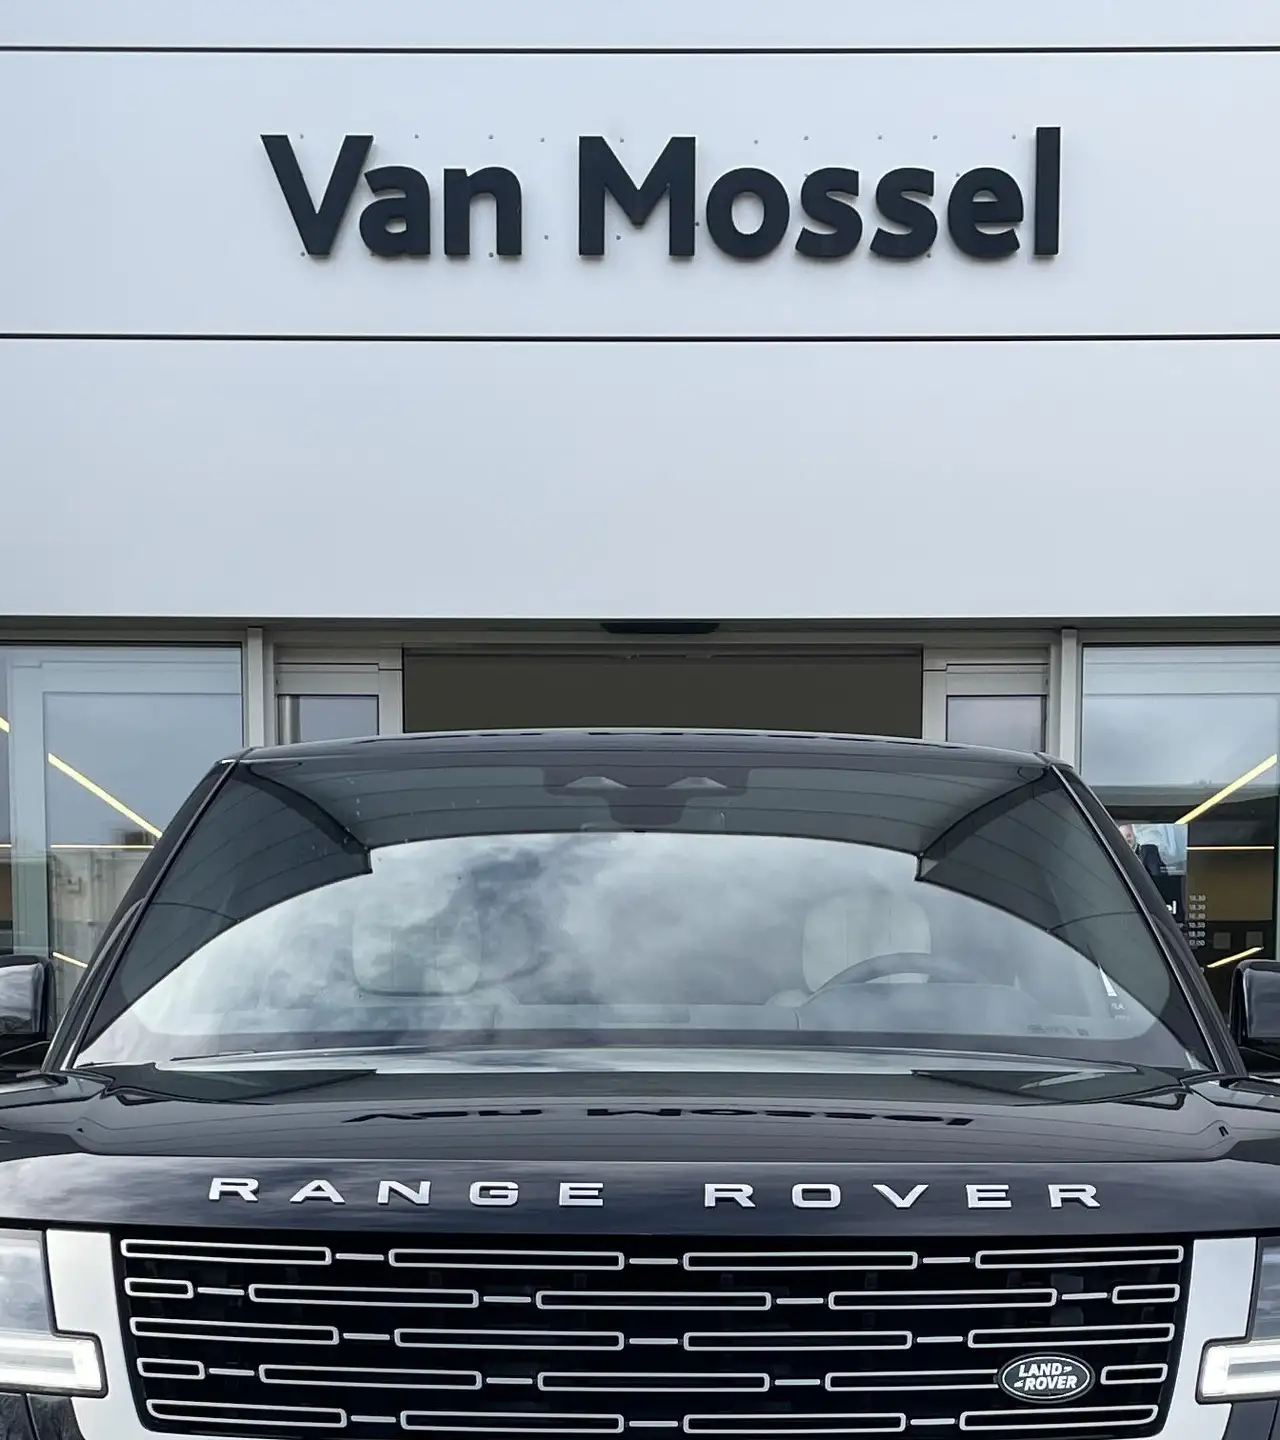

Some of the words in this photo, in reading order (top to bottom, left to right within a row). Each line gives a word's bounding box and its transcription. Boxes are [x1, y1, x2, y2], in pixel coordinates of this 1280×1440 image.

[261, 133, 523, 257] Van
[578, 127, 1062, 260] Mossel
[208, 1176, 605, 1208] RANGE
[703, 1182, 1103, 1210] ROVER
[1018, 1363, 1063, 1377] LAND
[1024, 1376, 1078, 1391] ROVER
